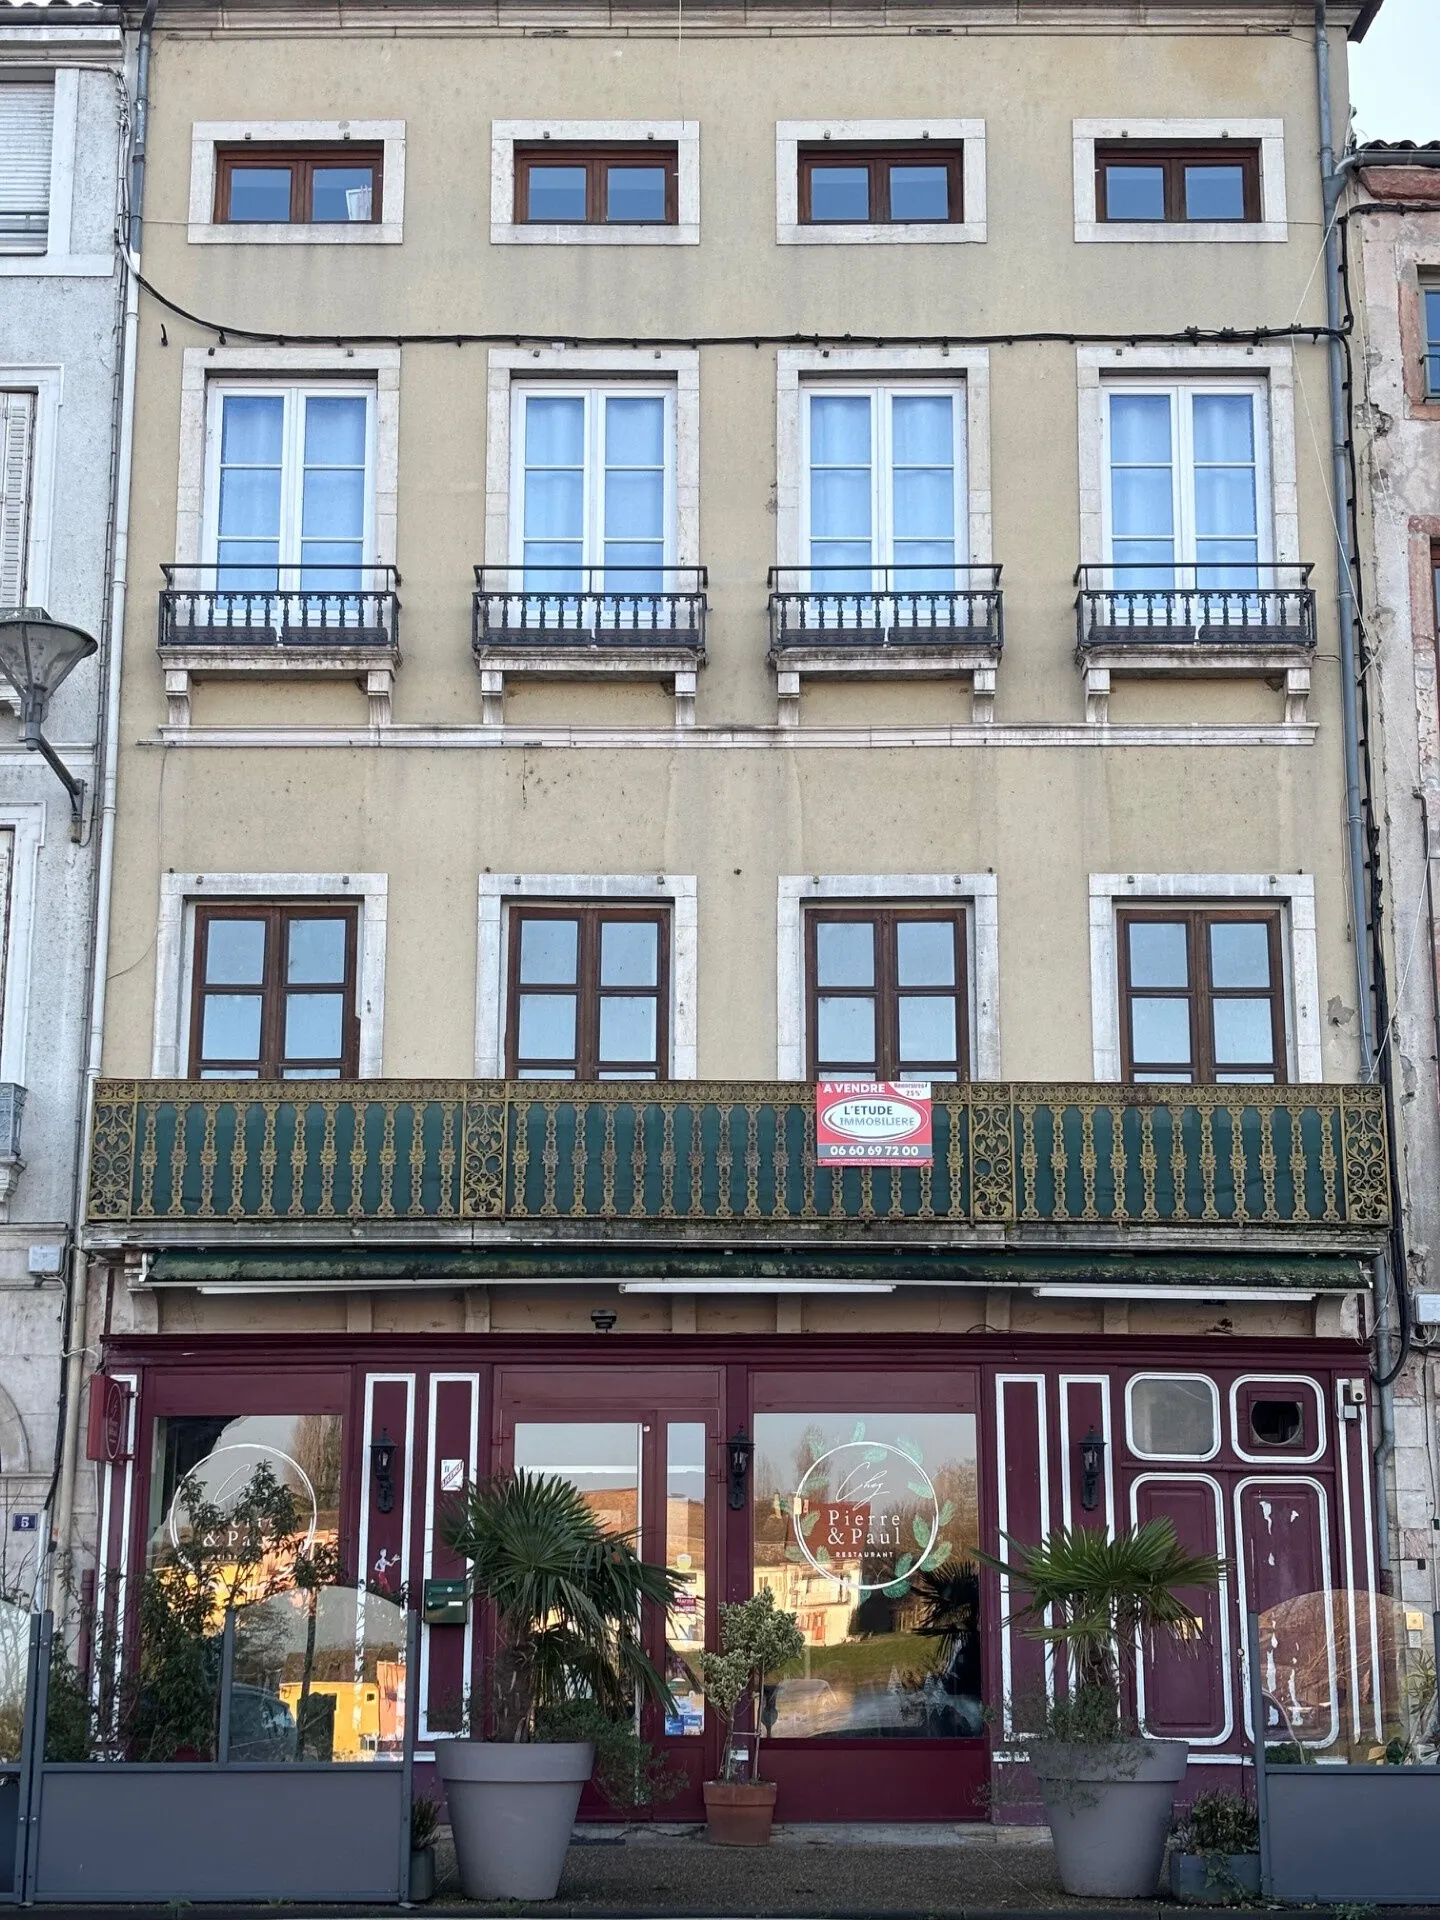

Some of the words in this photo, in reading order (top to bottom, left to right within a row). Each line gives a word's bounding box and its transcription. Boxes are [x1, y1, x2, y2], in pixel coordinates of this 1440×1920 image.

[823, 1083, 833, 1094] A
[835, 1083, 886, 1094] VENDRE
[844, 1105, 893, 1116] L'ETUDE
[839, 1117, 915, 1127] IMMOBILIERE
[830, 1146, 846, 1156] 06
[848, 1146, 865, 1156] 60
[867, 1146, 883, 1156] 69
[885, 1146, 900, 1156] 72
[902, 1146, 919, 1156] 00
[20, 1516, 30, 1528] 5
[828, 1510, 901, 1526] Pierre
[828, 1527, 845, 1545] &
[851, 1528, 901, 1545] Paul
